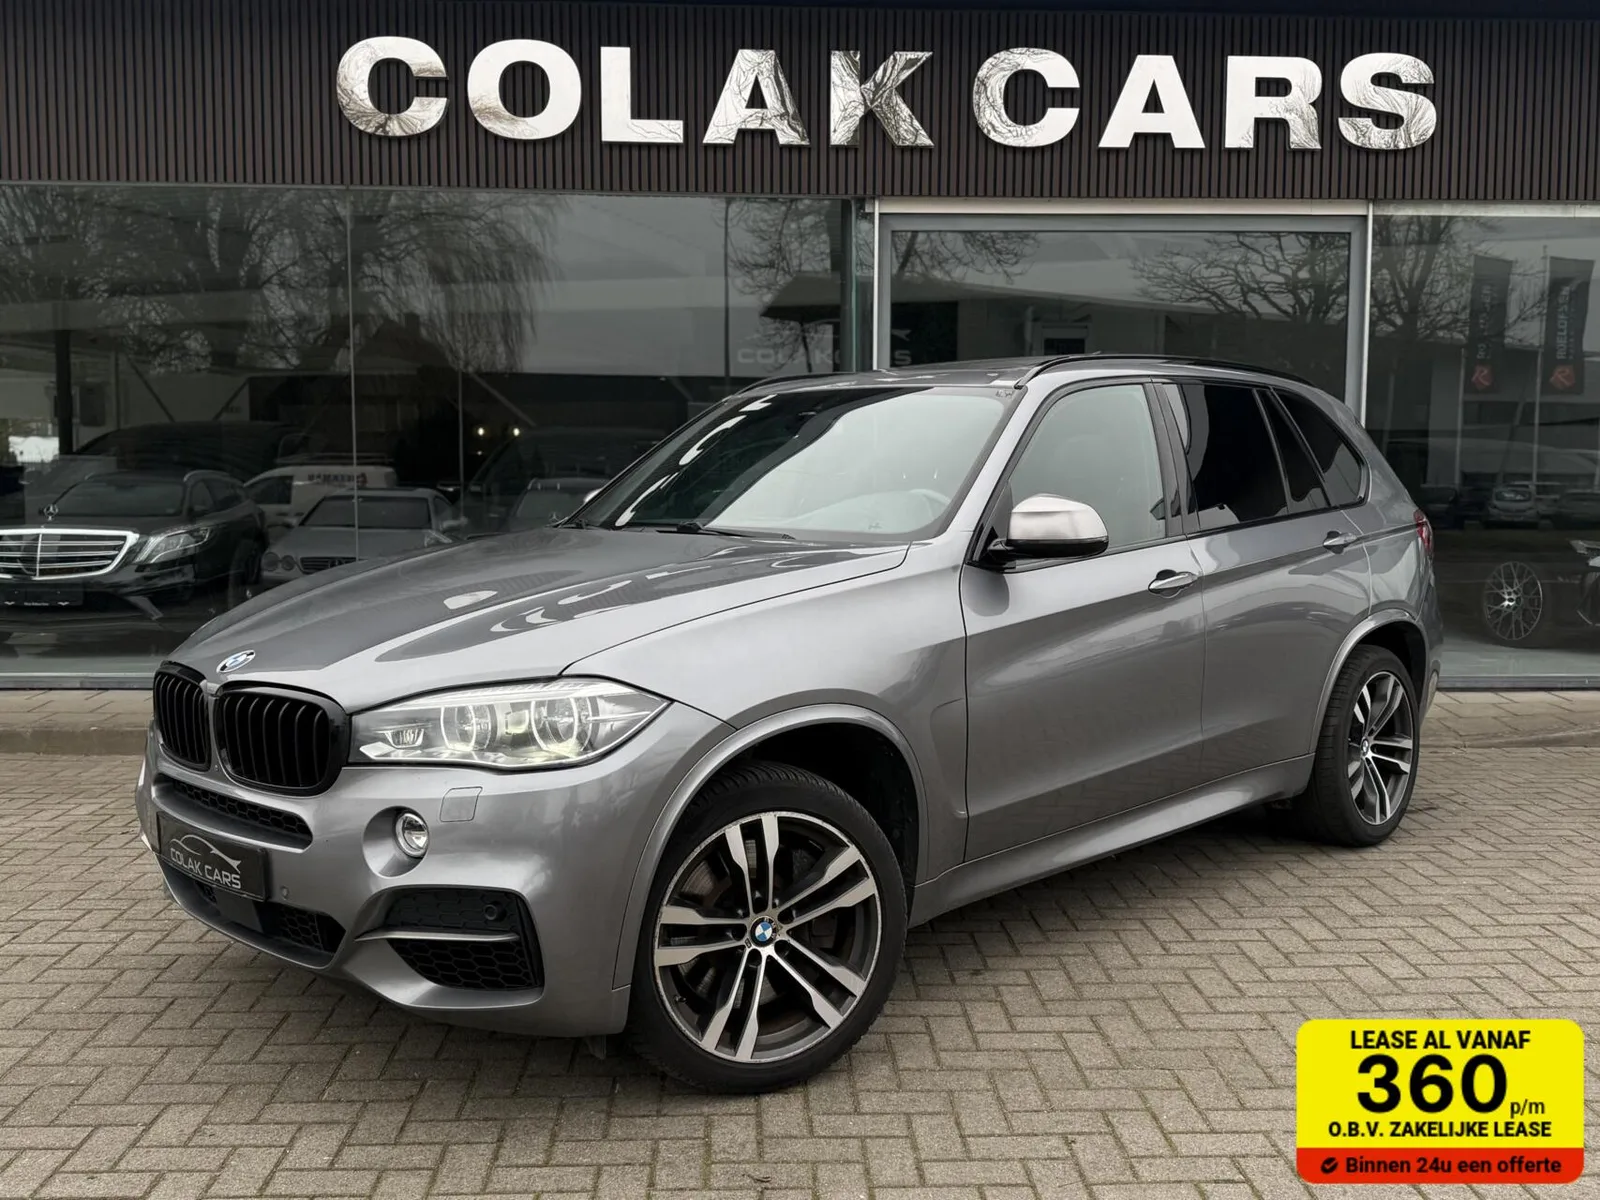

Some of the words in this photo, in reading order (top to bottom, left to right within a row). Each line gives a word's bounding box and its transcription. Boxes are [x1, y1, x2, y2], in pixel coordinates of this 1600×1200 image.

[336, 36, 935, 148] COLAK
[972, 47, 1438, 151] CARS
[170, 847, 203, 876] COLAK
[204, 864, 241, 889] CARS
